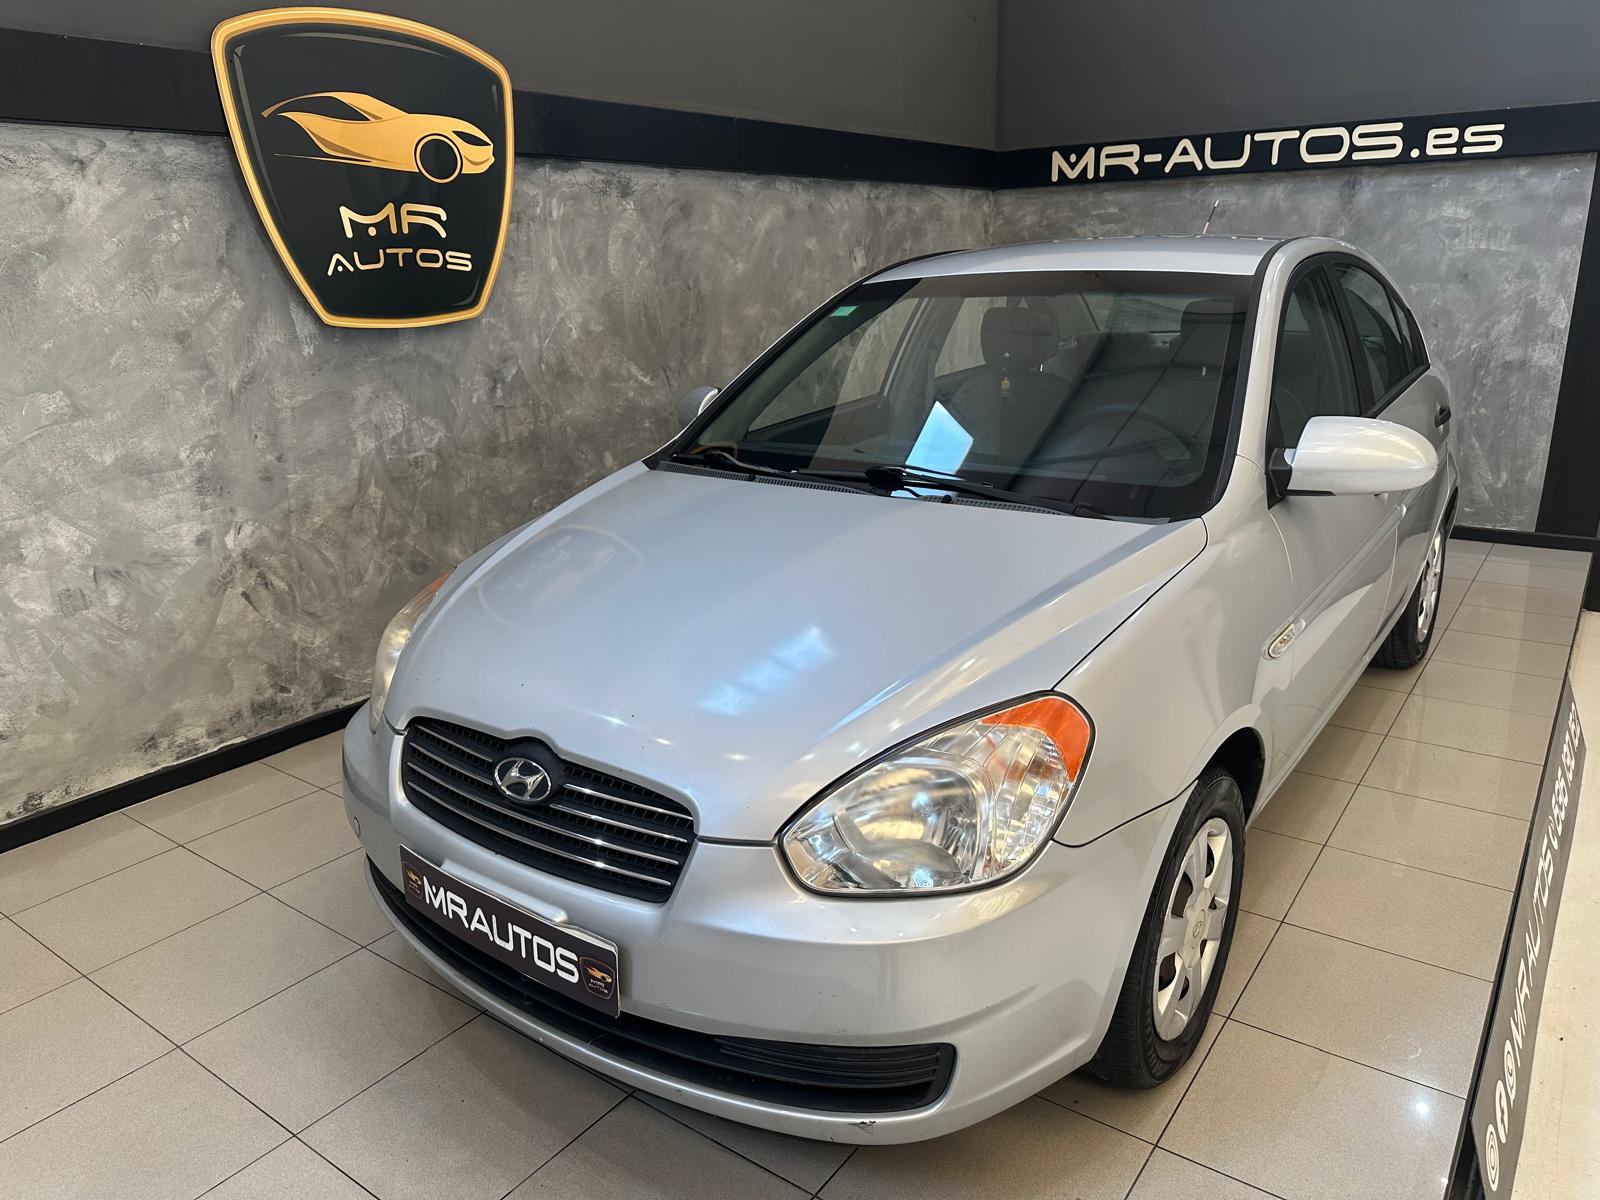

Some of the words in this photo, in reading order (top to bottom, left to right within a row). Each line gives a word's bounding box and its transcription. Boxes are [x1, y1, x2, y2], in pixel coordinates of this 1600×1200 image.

[1050, 121, 1506, 183] MR-AUTOS.es
[339, 202, 447, 239] MR
[327, 248, 473, 276] AUTOS
